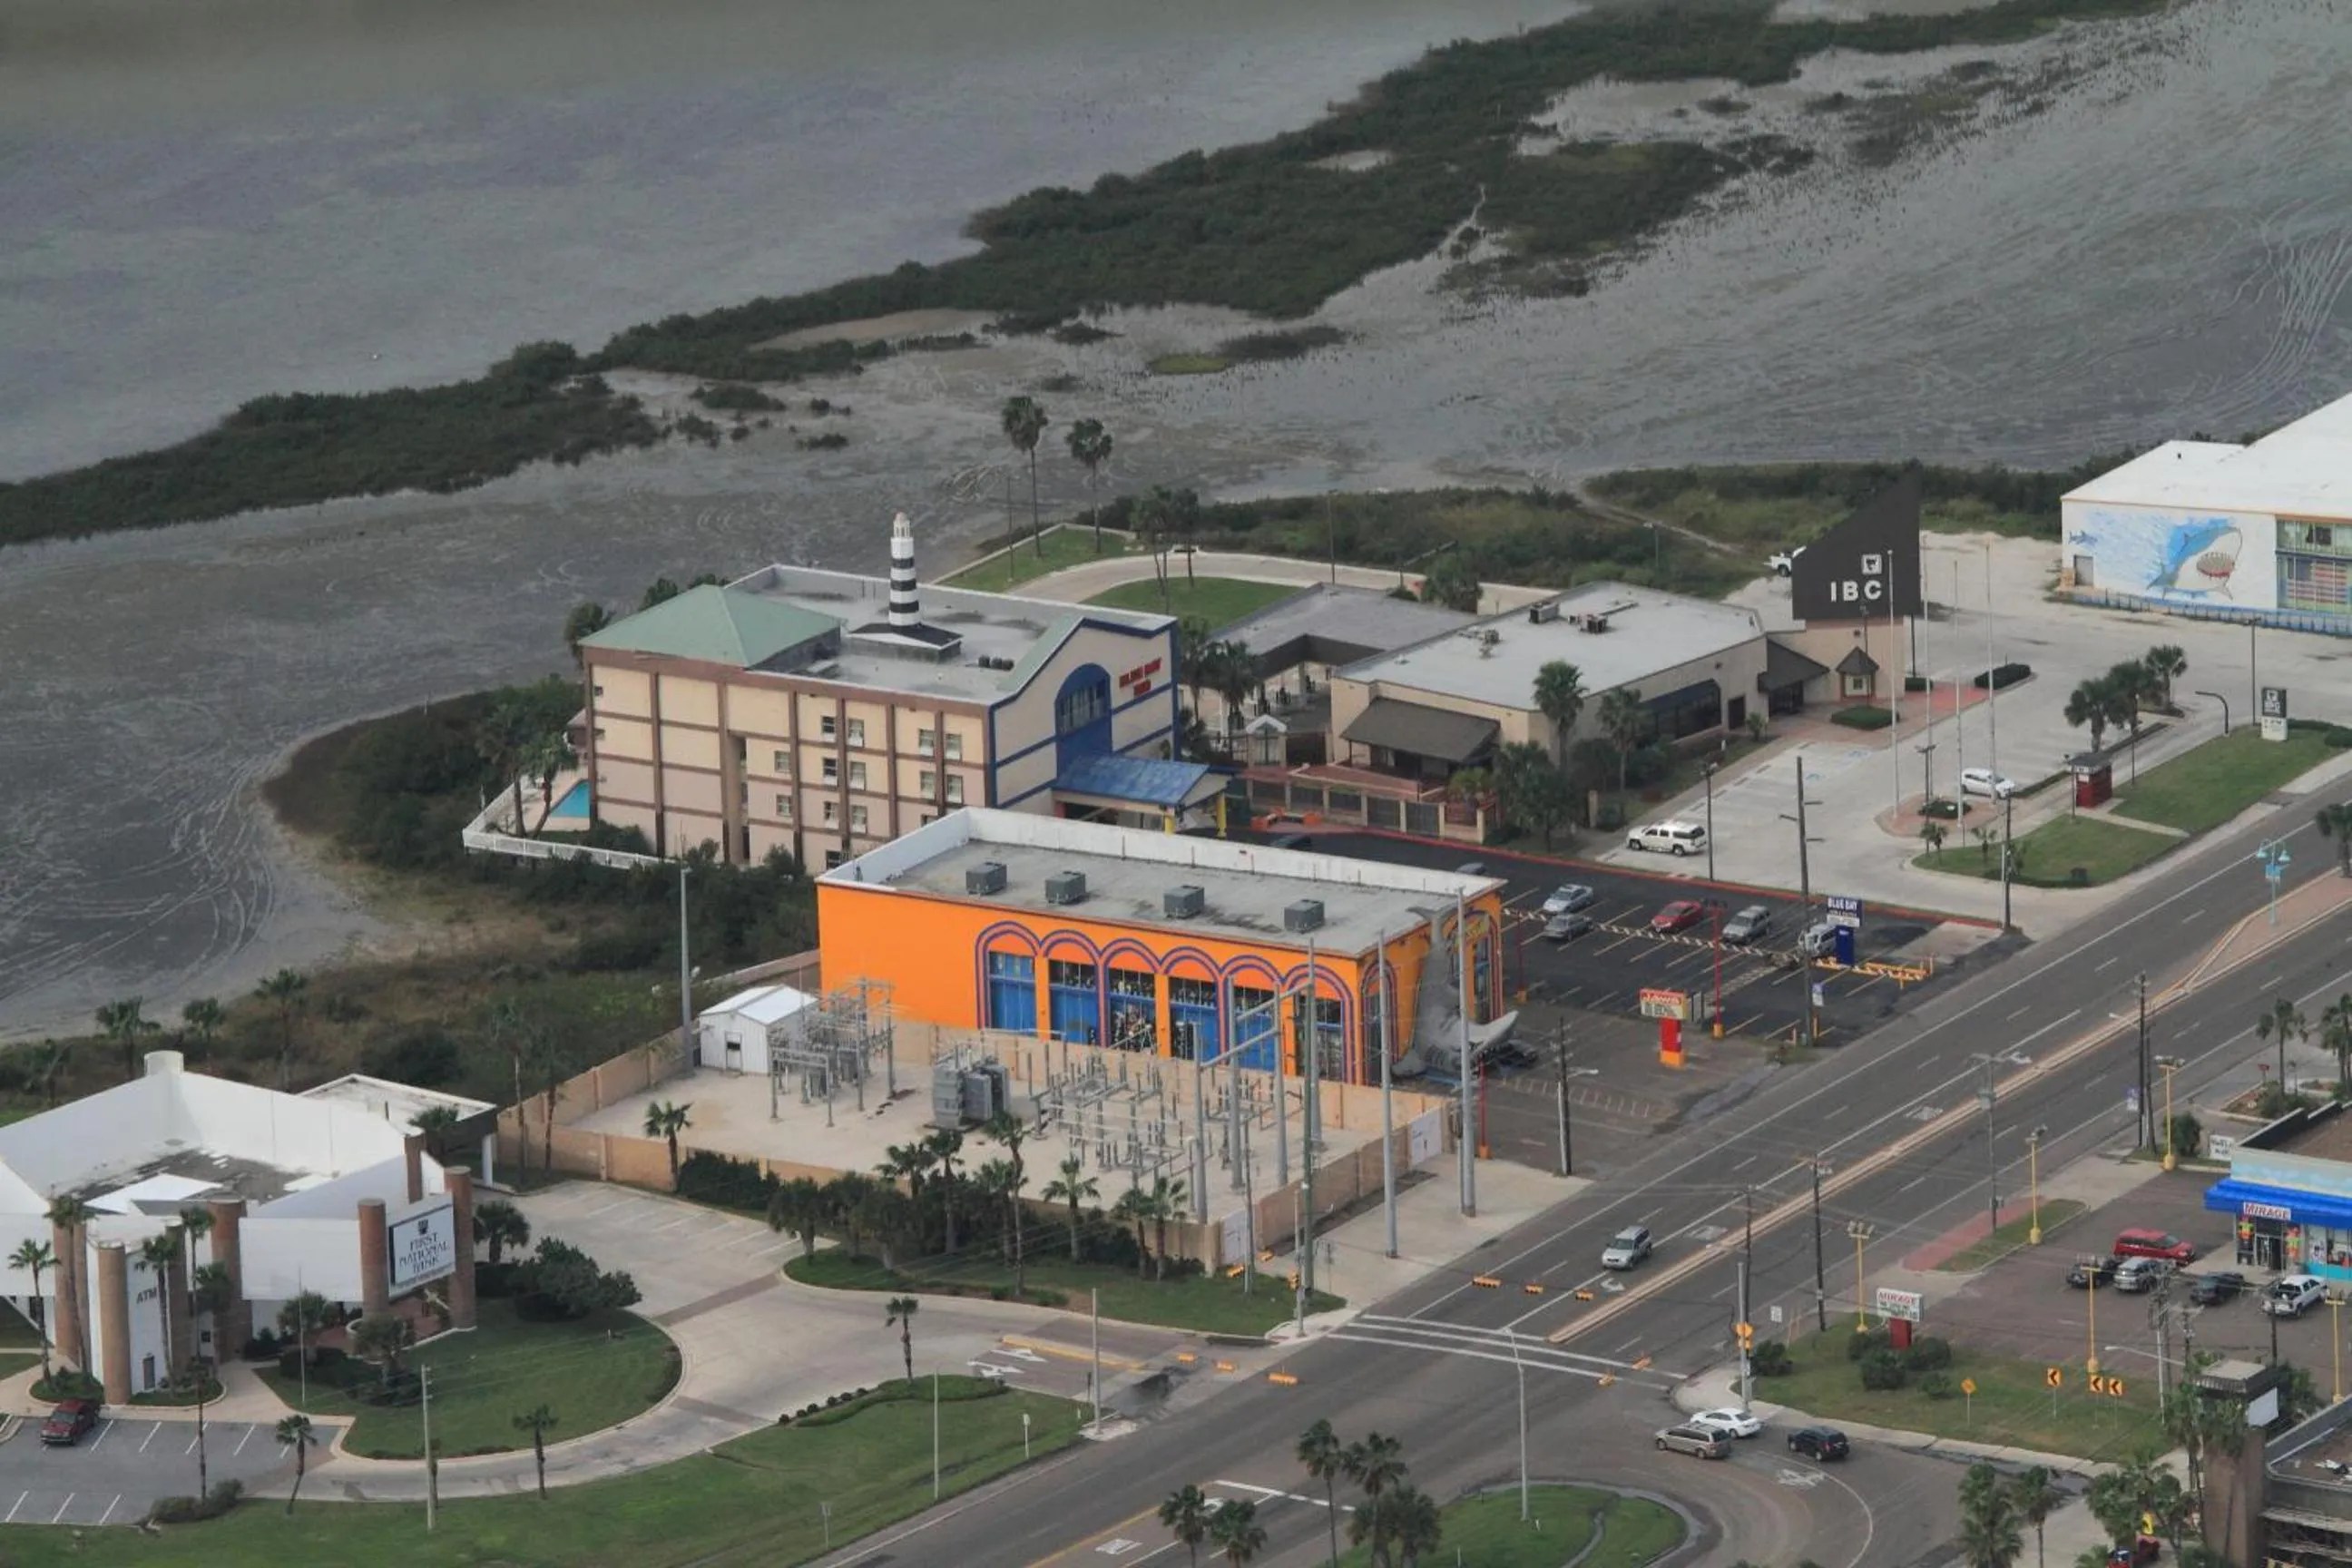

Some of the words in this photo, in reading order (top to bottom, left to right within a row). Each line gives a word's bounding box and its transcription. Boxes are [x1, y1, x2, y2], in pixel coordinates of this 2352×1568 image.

[1830, 580, 1882, 603] IBC
[1828, 897, 1844, 909] BLUE
[2244, 1202, 2288, 1219] MIRAGE
[410, 1232, 437, 1251] FIRST
[399, 1240, 449, 1268] NATIONAL
[136, 1287, 158, 1305] ATM
[1879, 1291, 1915, 1305] MIRAGE
